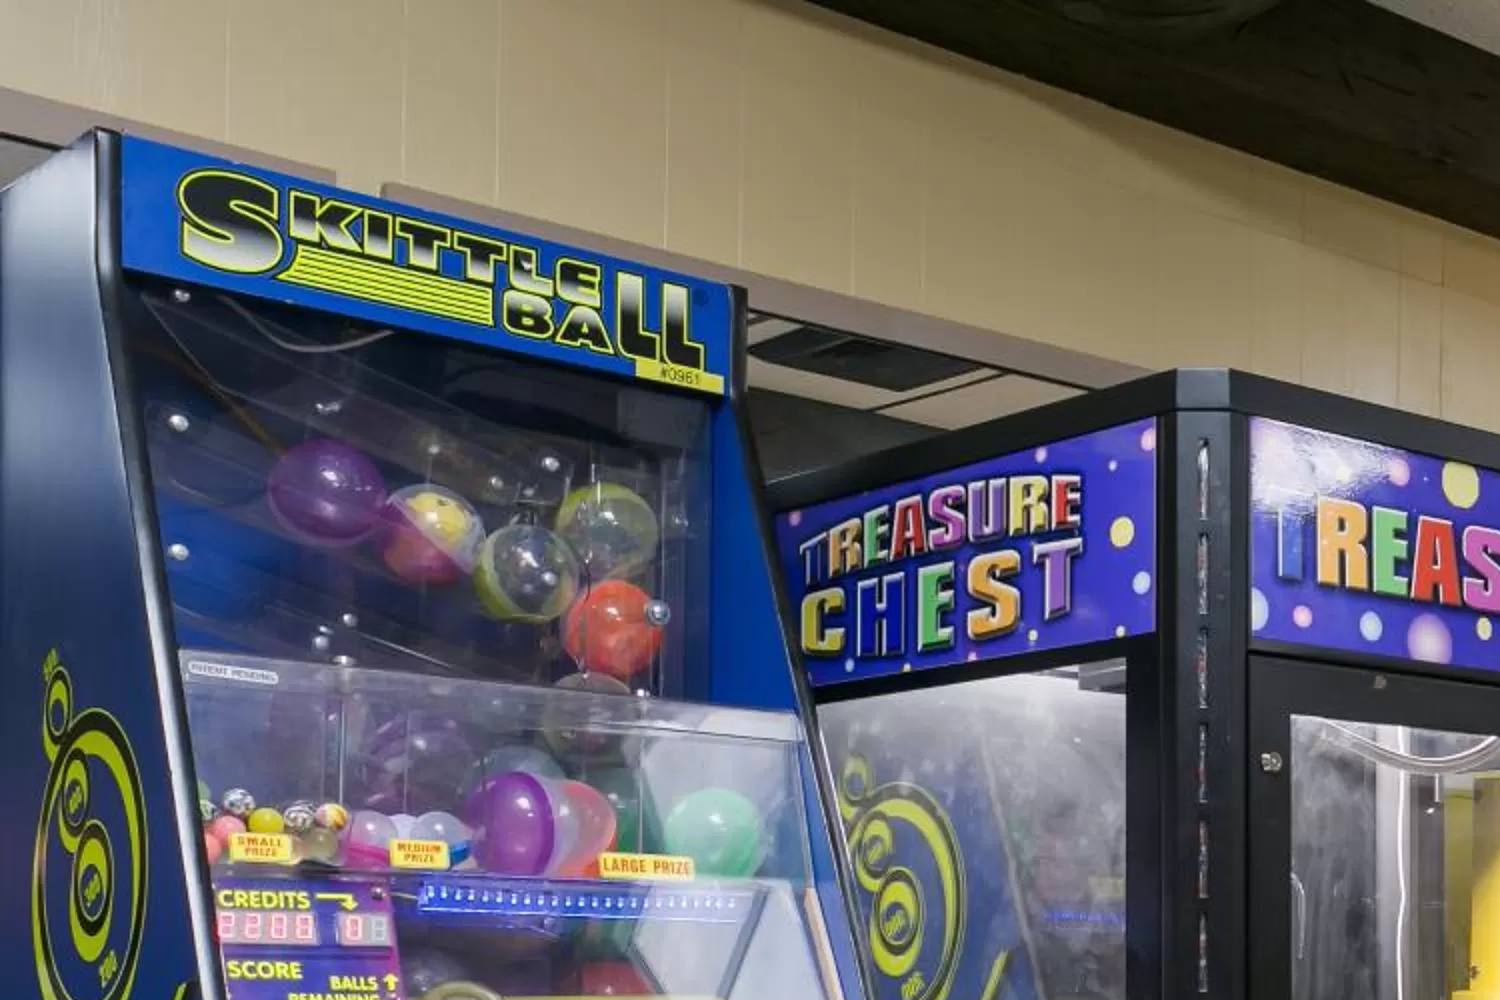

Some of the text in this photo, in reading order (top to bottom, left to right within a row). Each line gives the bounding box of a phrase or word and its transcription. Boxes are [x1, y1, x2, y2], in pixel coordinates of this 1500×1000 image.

[176, 168, 706, 373] SKITTLE BALL
[799, 474, 1082, 586] TREASURE
[800, 536, 1083, 657] CHEST
[237, 835, 284, 848] SMALL
[397, 842, 442, 853] MEDIUM
[244, 847, 278, 858] PRIZE
[403, 852, 436, 863] PRIZE
[602, 856, 691, 876] LARGE PRIZE
[217, 889, 312, 910] CREDITS
[226, 960, 304, 980] SCORE
[329, 975, 379, 991] BALLS
